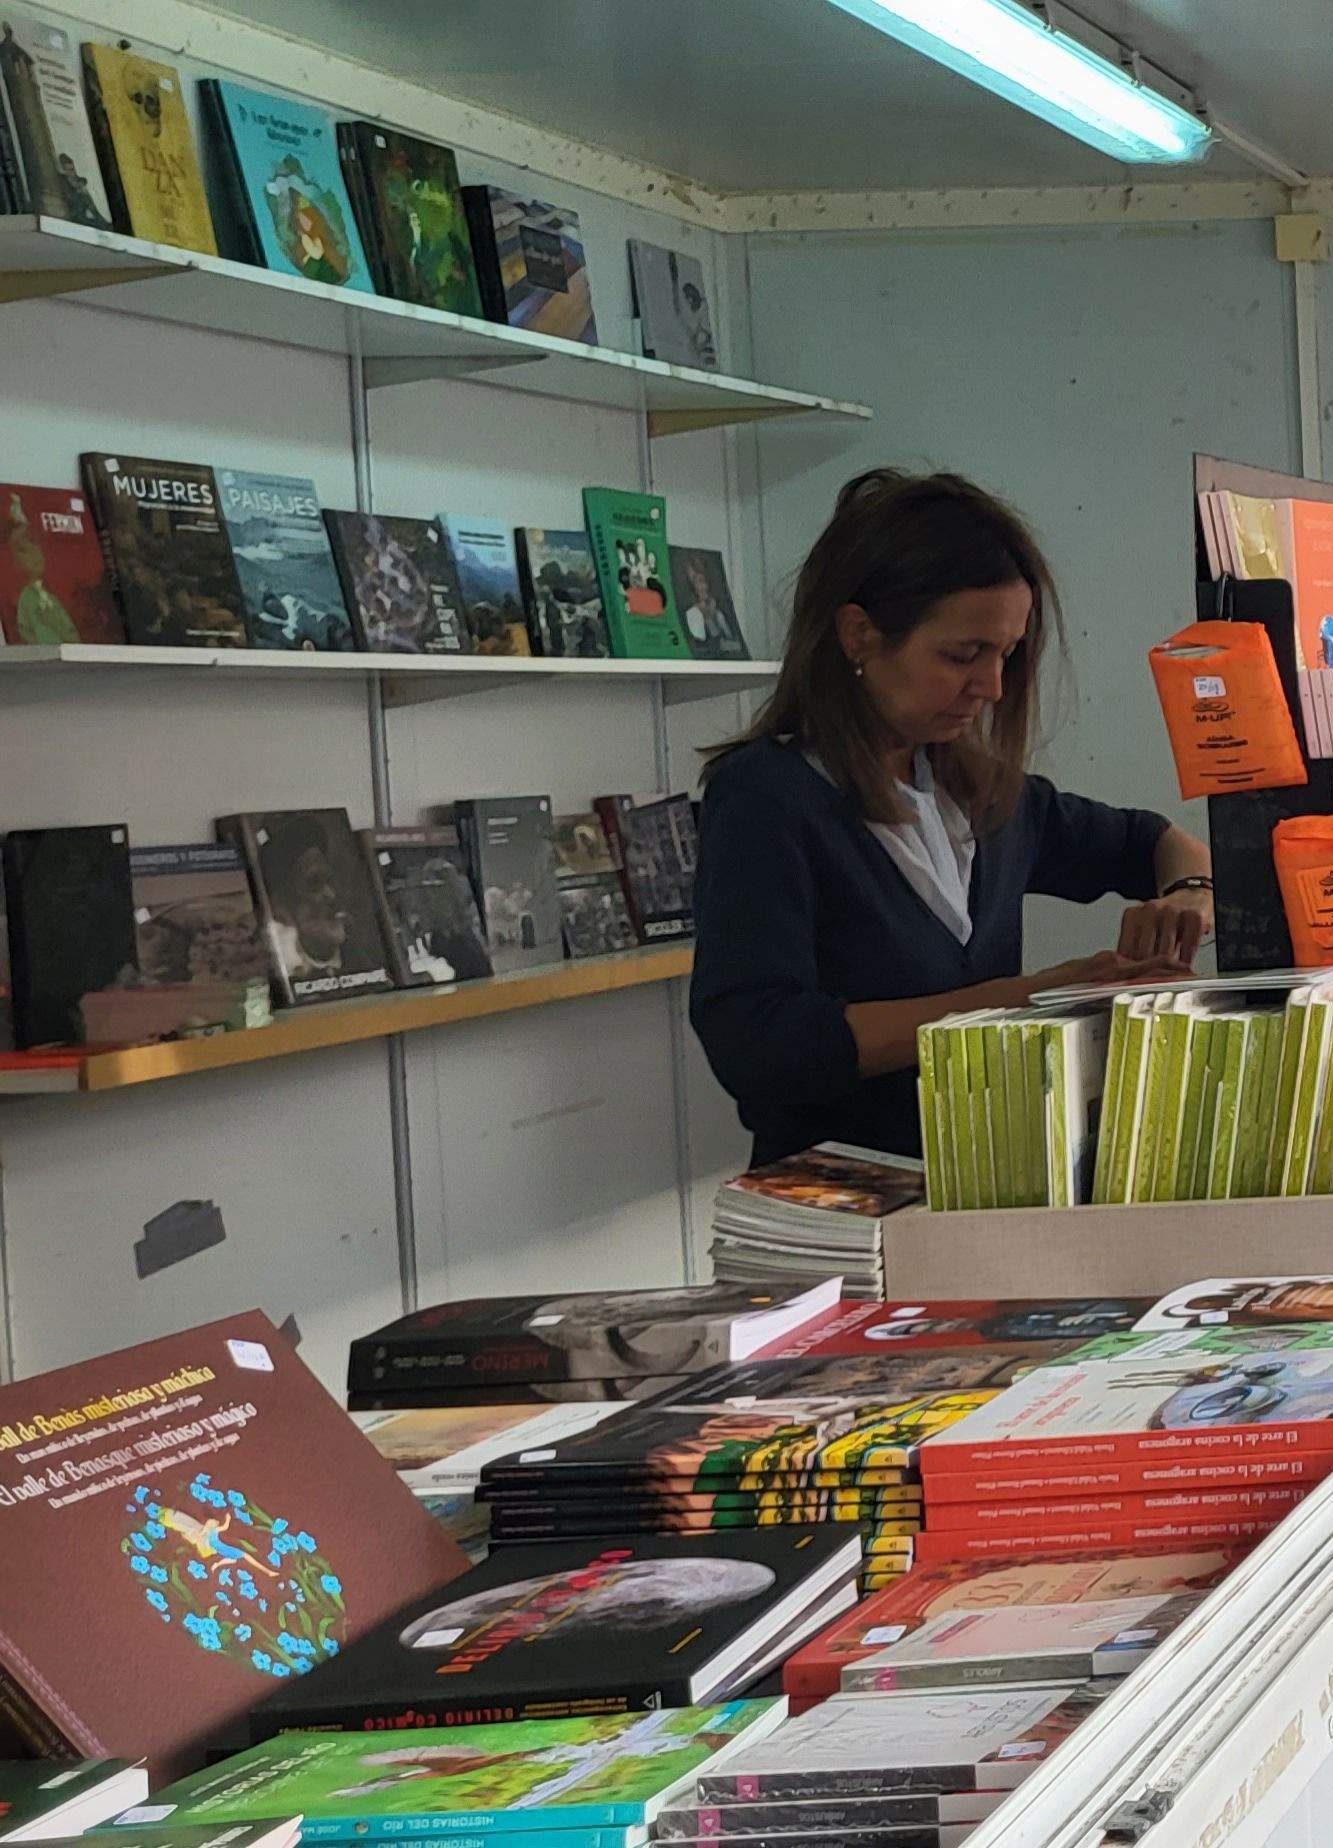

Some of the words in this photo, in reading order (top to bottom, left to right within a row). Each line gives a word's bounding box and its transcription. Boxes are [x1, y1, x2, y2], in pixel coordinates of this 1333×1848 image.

[113, 475, 214, 505] MUJERES
[228, 487, 319, 517] PAISAJES
[20, 1413, 39, 1444] de
[149, 1383, 165, 1406] y
[1138, 1435, 1194, 1451] aragonesa
[1195, 1434, 1232, 1448] cocina
[1234, 1434, 1245, 1446] la
[1246, 1431, 1261, 1445] de
[1262, 1431, 1285, 1443] arte
[1286, 1431, 1299, 1443] El
[12, 1470, 48, 1502] valle
[46, 1465, 68, 1489] de
[65, 1444, 135, 1481] Benasque
[199, 1417, 214, 1439] y
[1143, 1466, 1198, 1481] aragonesa
[1200, 1465, 1236, 1479] cocina
[1238, 1465, 1248, 1478] la
[1249, 1463, 1264, 1477] de
[1267, 1462, 1290, 1475] arte
[1291, 1461, 1303, 1475] El
[1145, 1493, 1199, 1509] aragonesa
[1201, 1493, 1238, 1507] cocina
[1240, 1492, 1250, 1506] la
[1252, 1491, 1267, 1504] de
[1269, 1490, 1291, 1503] arte
[1134, 1523, 1189, 1539] aragonesa
[1190, 1522, 1227, 1537] cocina
[1229, 1522, 1240, 1536] la
[1243, 1521, 1257, 1535] de
[446, 1707, 514, 1724] DELIRIO
[383, 1820, 405, 1833] RÍO
[407, 1819, 430, 1831] DEL
[433, 1815, 495, 1829] HISTORIAS
